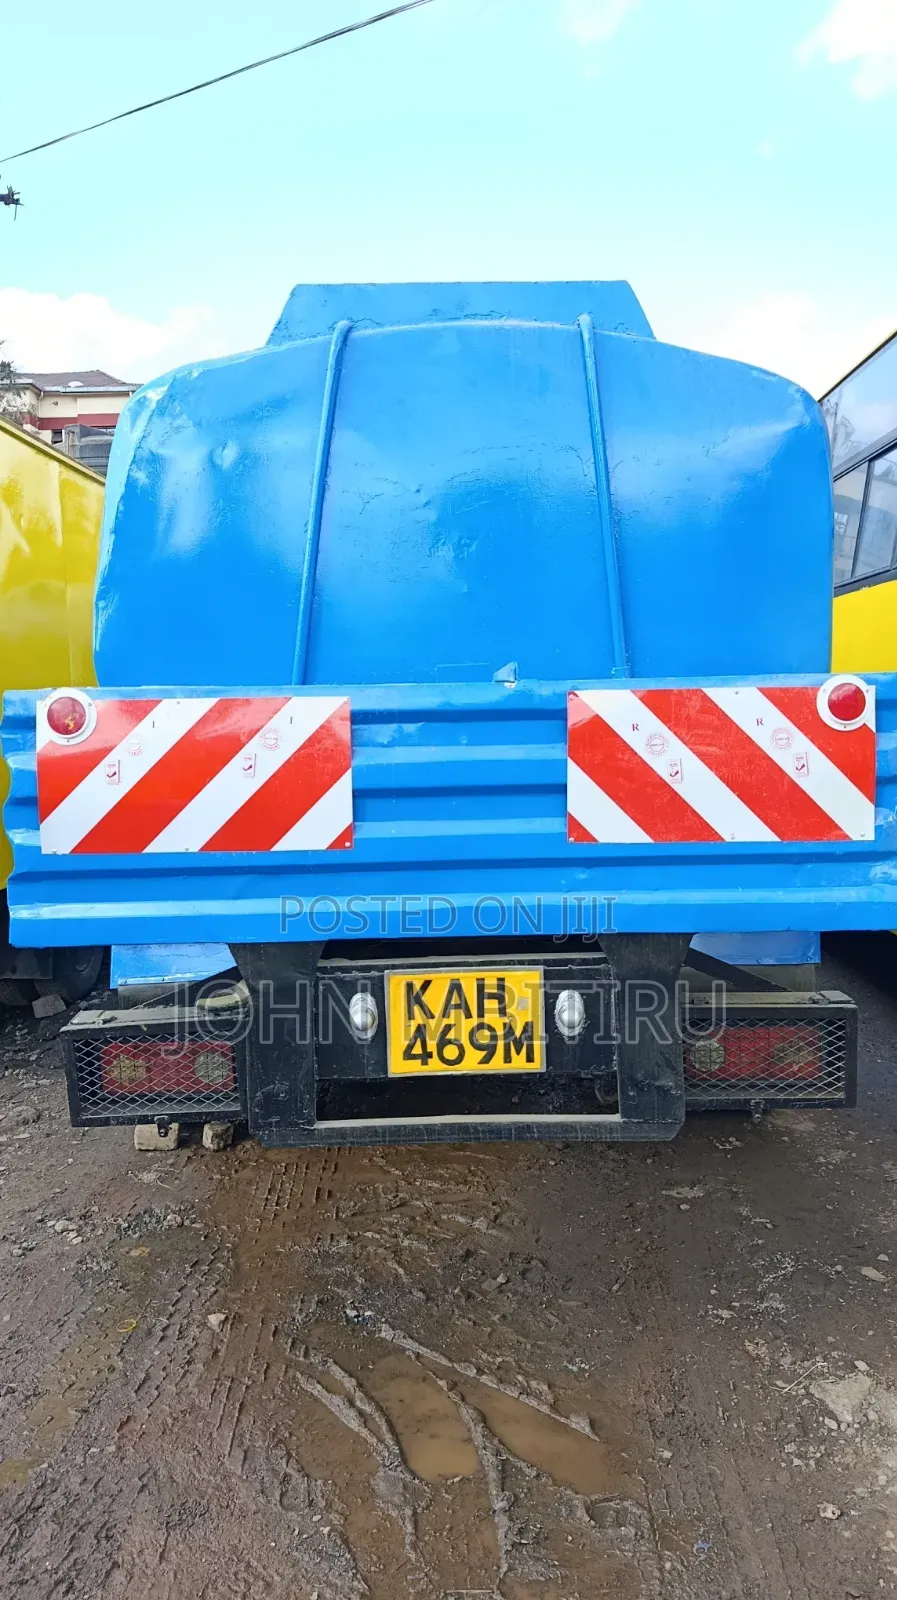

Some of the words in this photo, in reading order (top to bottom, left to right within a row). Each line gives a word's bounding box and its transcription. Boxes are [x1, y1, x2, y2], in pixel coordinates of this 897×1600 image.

[631, 723, 640, 732] R
[756, 718, 764, 727] R
[405, 978, 507, 1021] KAH
[402, 1021, 535, 1066] 469M
